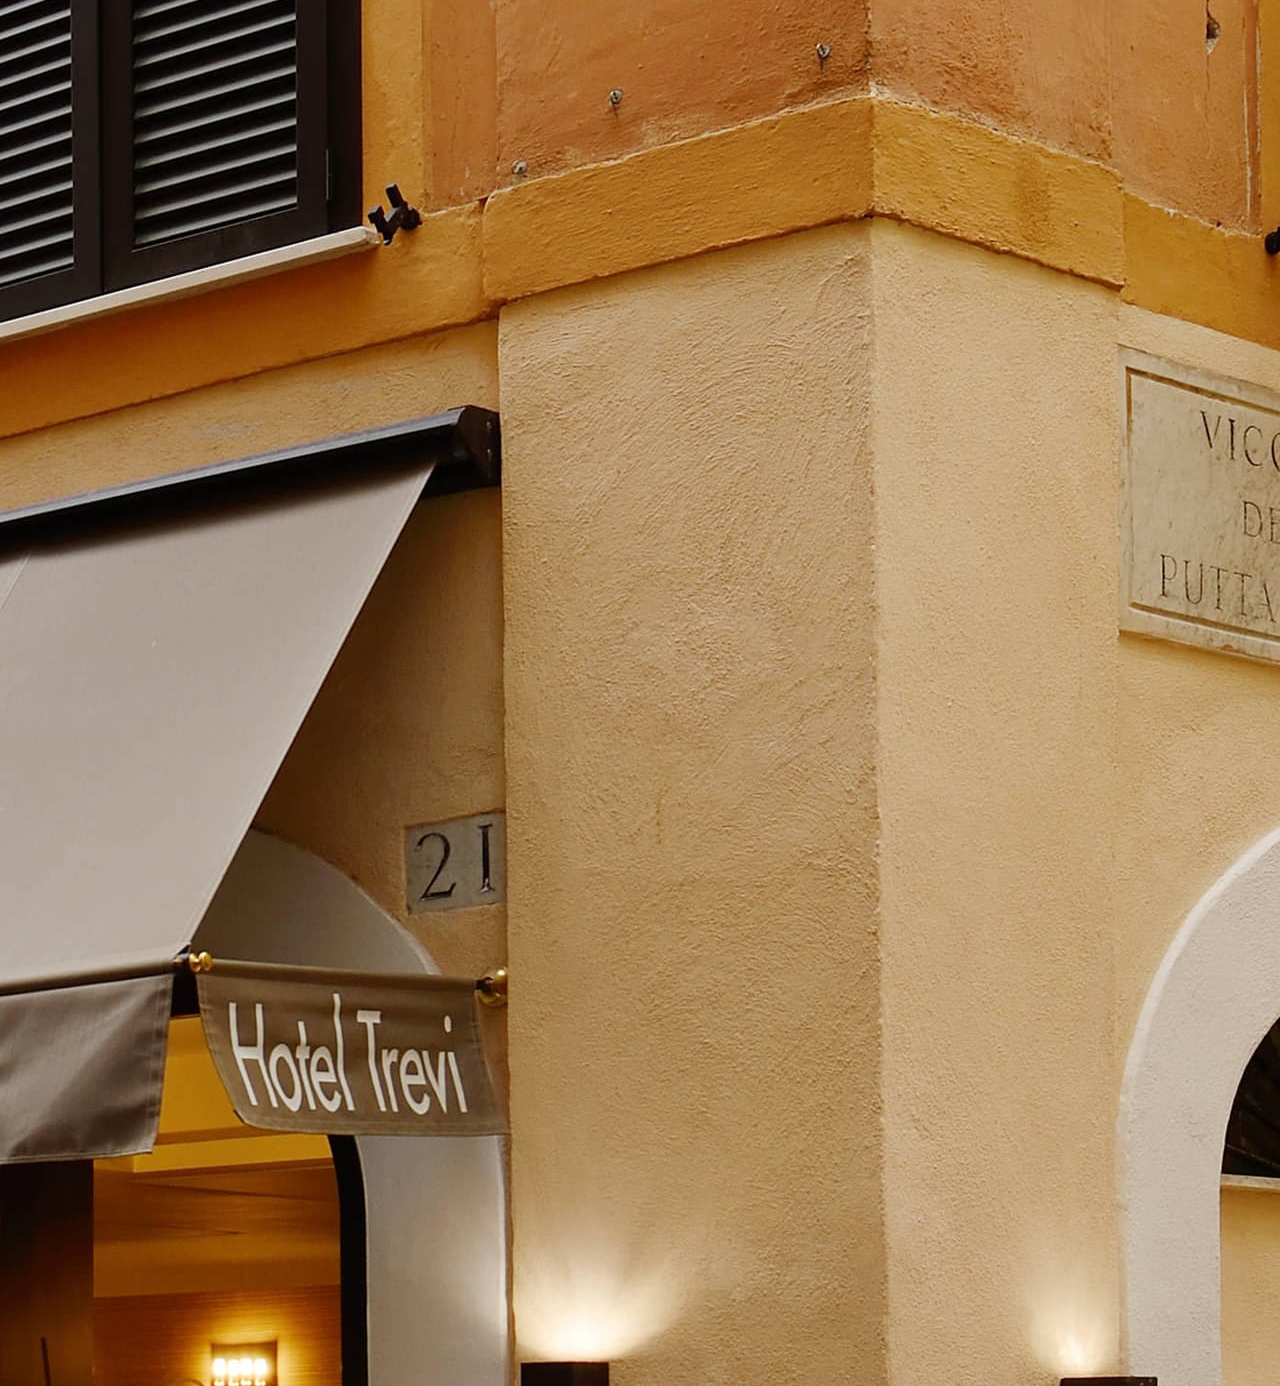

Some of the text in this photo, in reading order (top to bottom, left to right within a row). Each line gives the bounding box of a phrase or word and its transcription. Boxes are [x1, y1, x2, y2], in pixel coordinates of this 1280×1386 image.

[413, 823, 497, 902] 21
[229, 993, 468, 1115] Hotel Trevi
